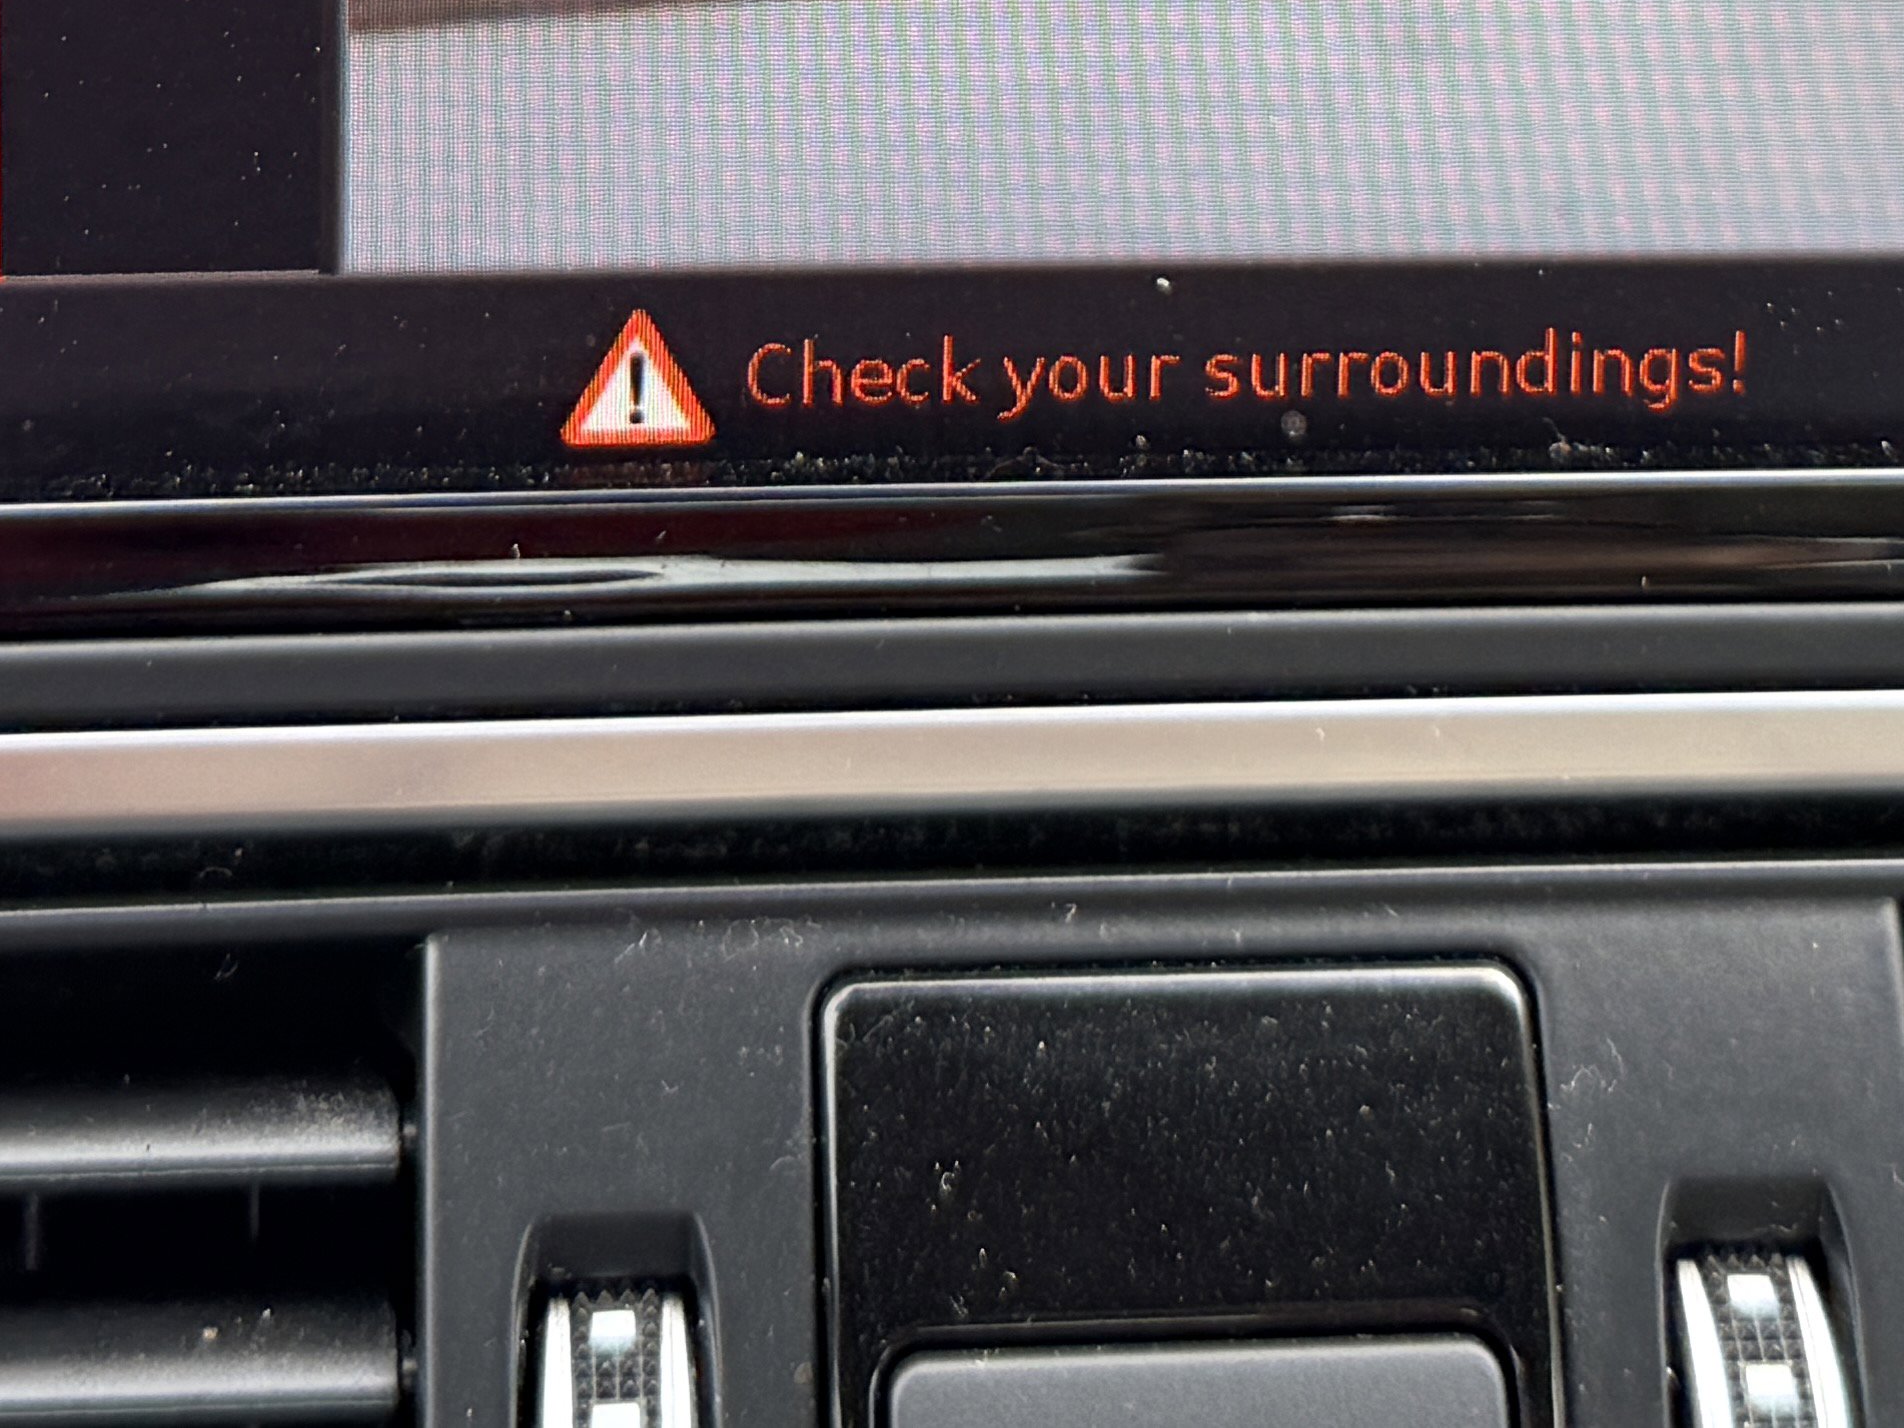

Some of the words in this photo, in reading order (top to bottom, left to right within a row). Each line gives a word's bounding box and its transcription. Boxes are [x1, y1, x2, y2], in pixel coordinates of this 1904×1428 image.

[746, 335, 979, 407] Check
[998, 354, 1181, 421] your
[1205, 327, 1747, 412] surroundings!
